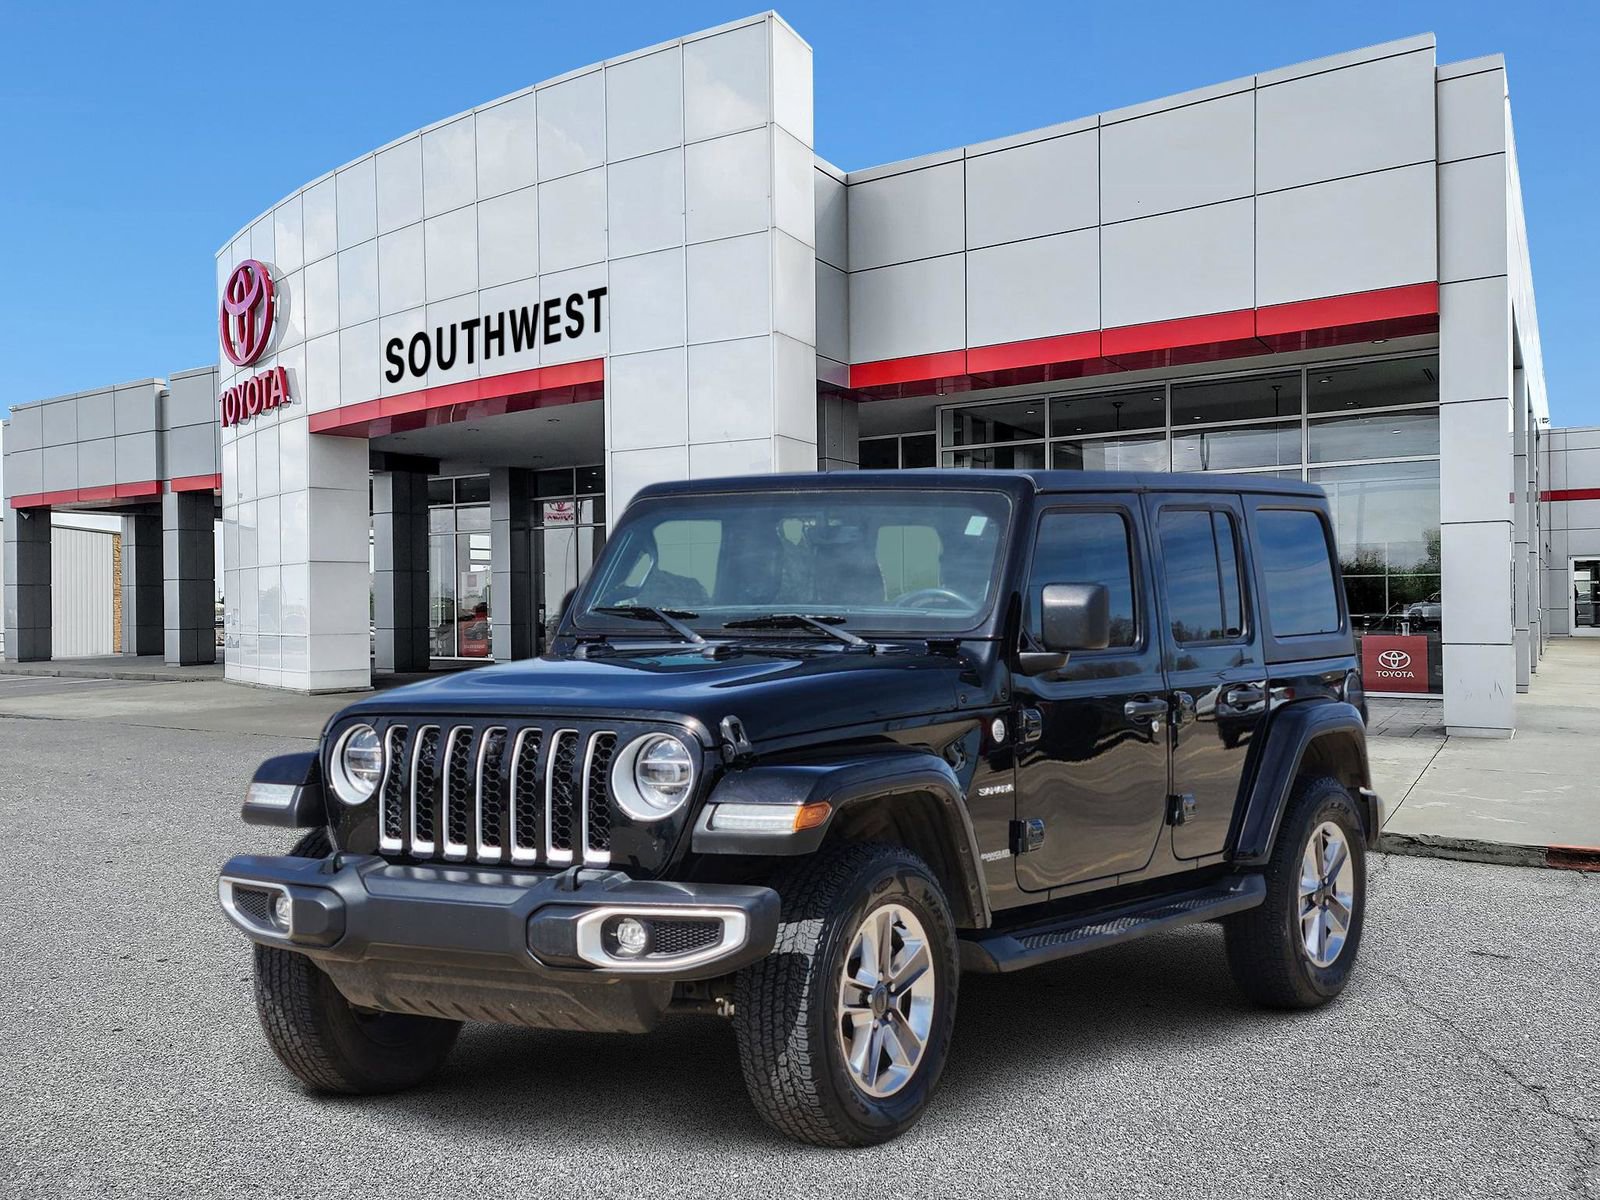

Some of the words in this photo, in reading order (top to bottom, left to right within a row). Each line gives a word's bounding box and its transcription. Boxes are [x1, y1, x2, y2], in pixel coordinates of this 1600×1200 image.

[385, 287, 608, 383] SOUTHWEST
[219, 366, 288, 427] TOYOTA
[1376, 670, 1415, 678] TOYOTA
